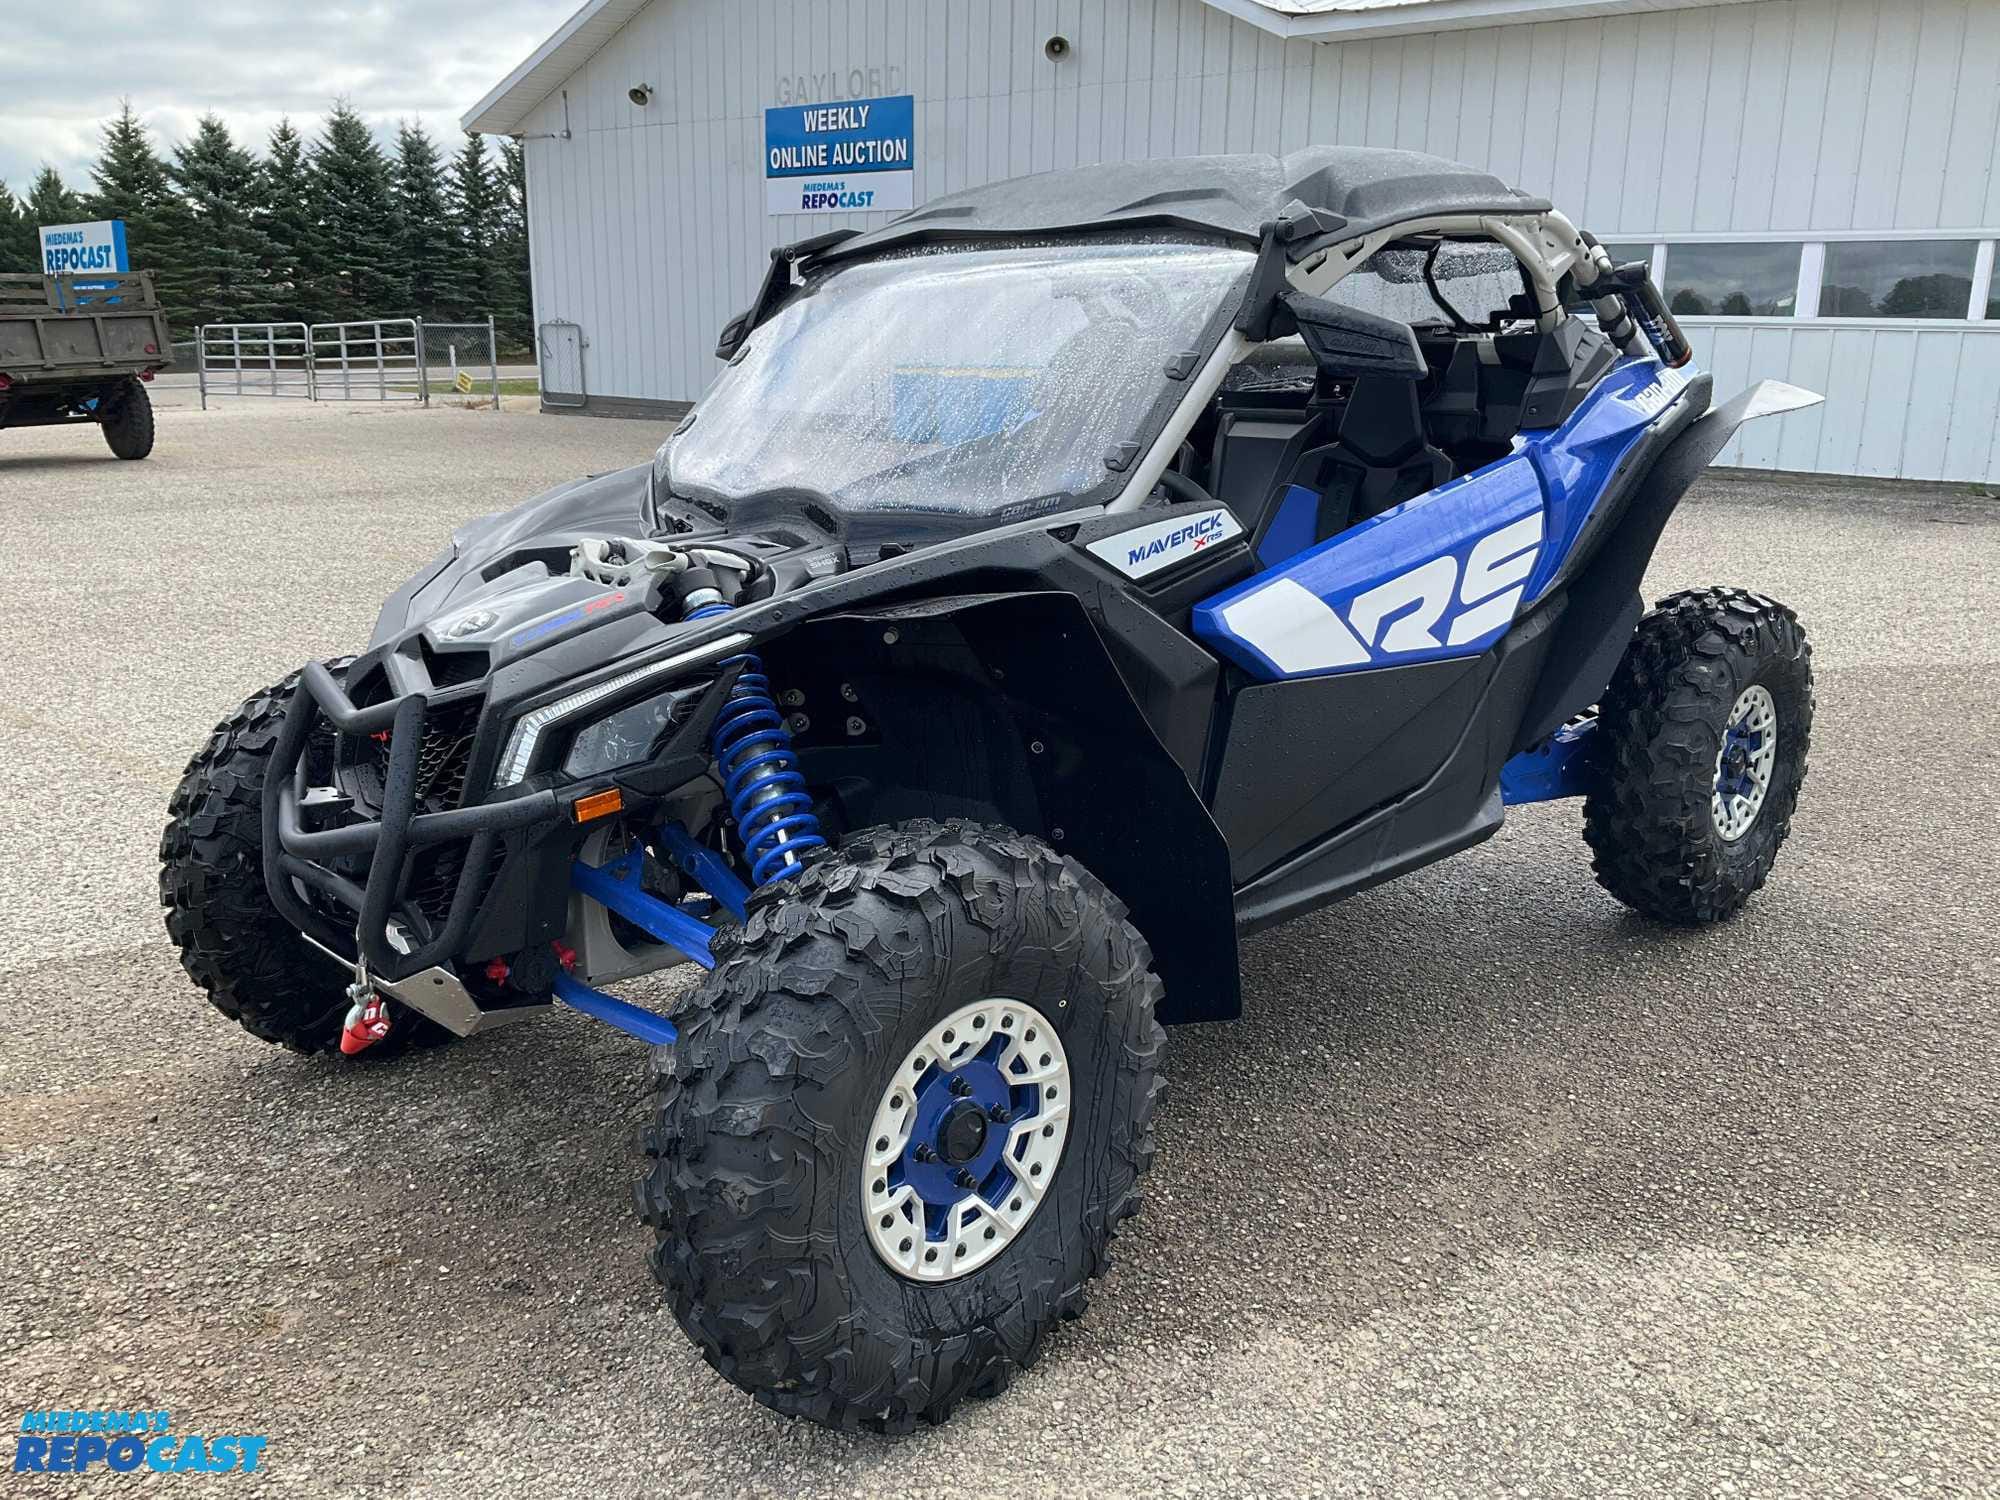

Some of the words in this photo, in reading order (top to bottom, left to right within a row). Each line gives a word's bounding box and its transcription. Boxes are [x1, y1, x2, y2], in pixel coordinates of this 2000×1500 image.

[803, 105, 870, 132] WEEKLY
[770, 144, 827, 169] ONLINE
[832, 138, 907, 165] AUCTION
[802, 191, 874, 209] REPOCAST
[803, 182, 845, 193] MIEDEMA'S
[45, 231, 84, 246] MIEDEMA'S
[46, 245, 111, 271] REPOCAST
[1128, 512, 1223, 566] MAVERICK
[1348, 510, 1544, 653] RS
